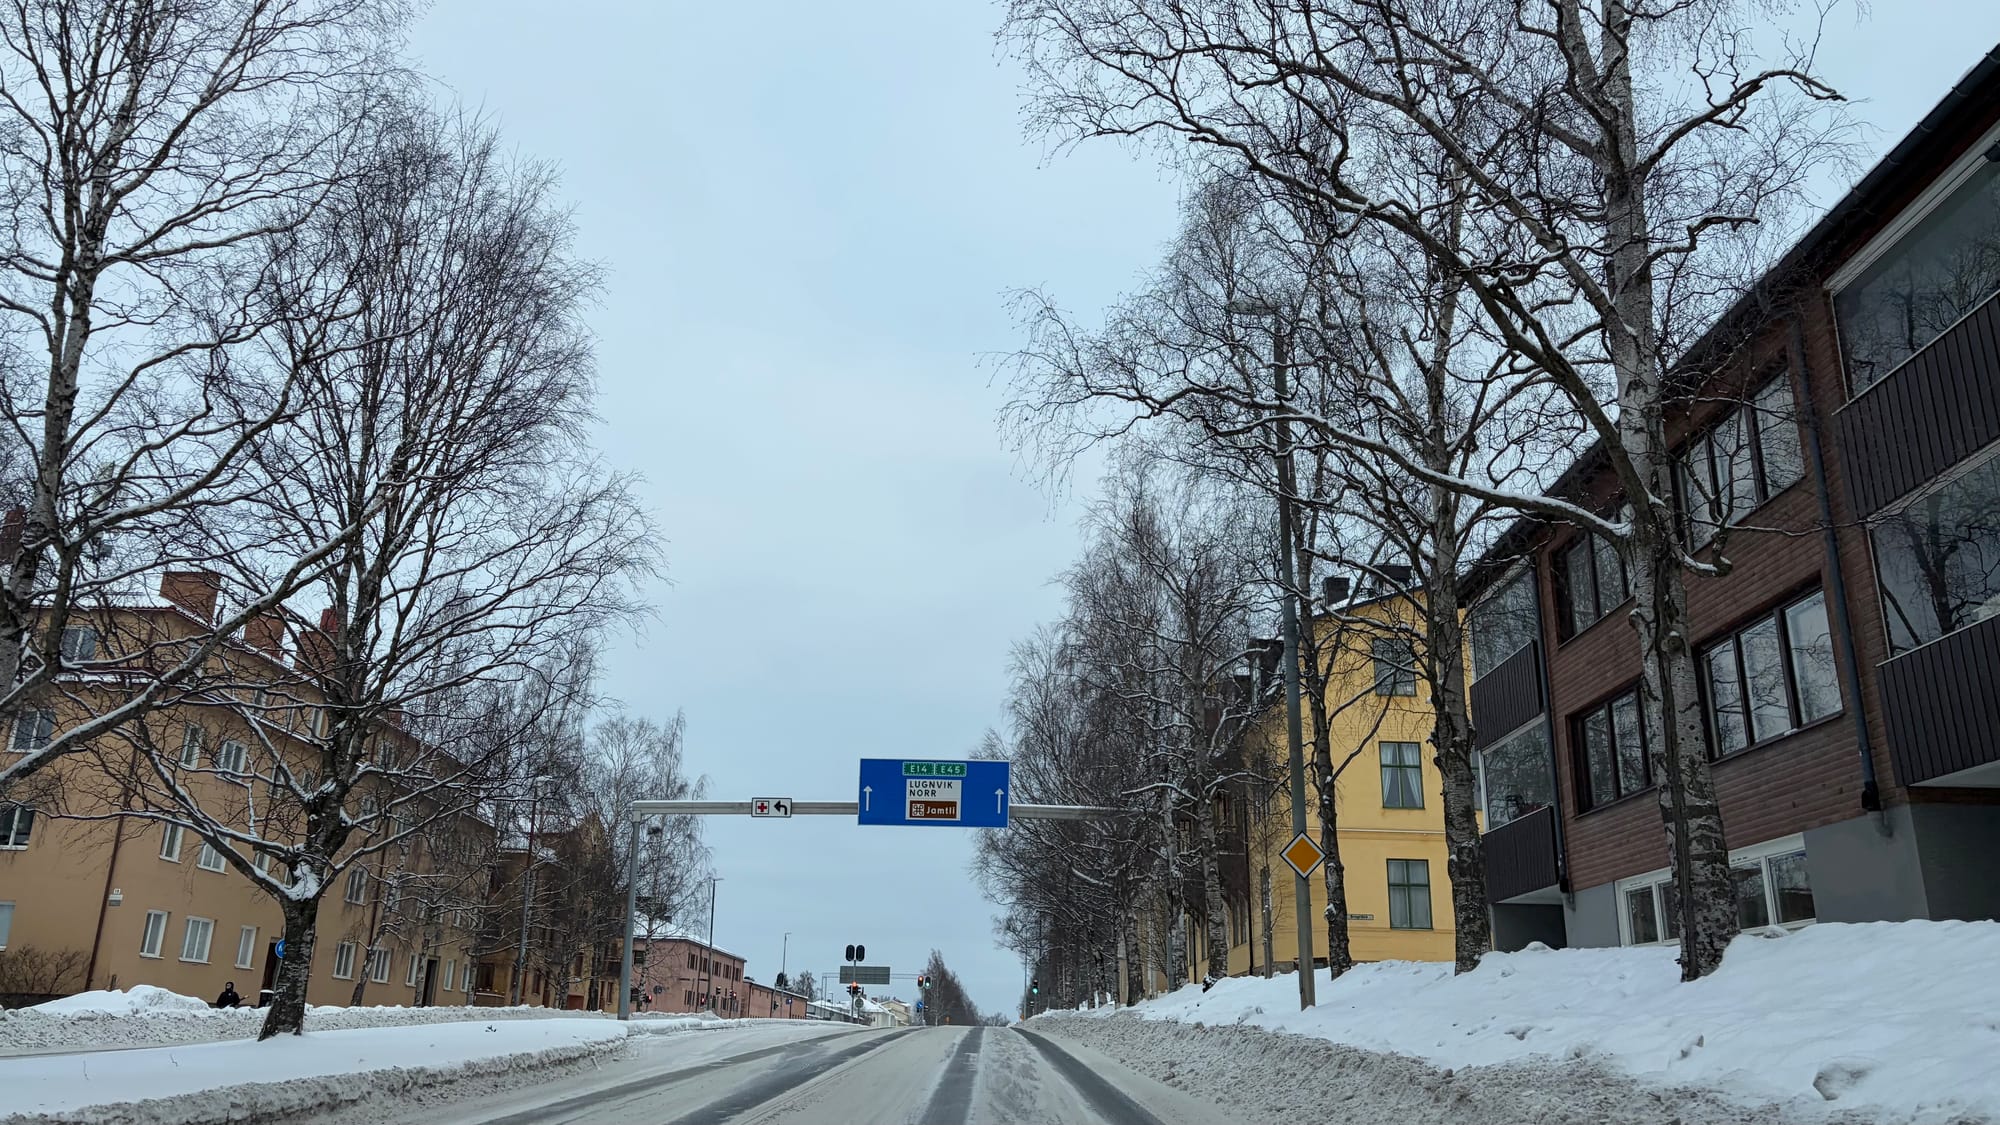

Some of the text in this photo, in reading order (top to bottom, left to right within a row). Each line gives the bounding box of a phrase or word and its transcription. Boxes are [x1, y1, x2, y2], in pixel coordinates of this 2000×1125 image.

[910, 765, 961, 774] E14 E45
[909, 781, 953, 789] LUGNVIK
[909, 789, 937, 797] NORR
[926, 806, 956, 815] Jamtli
